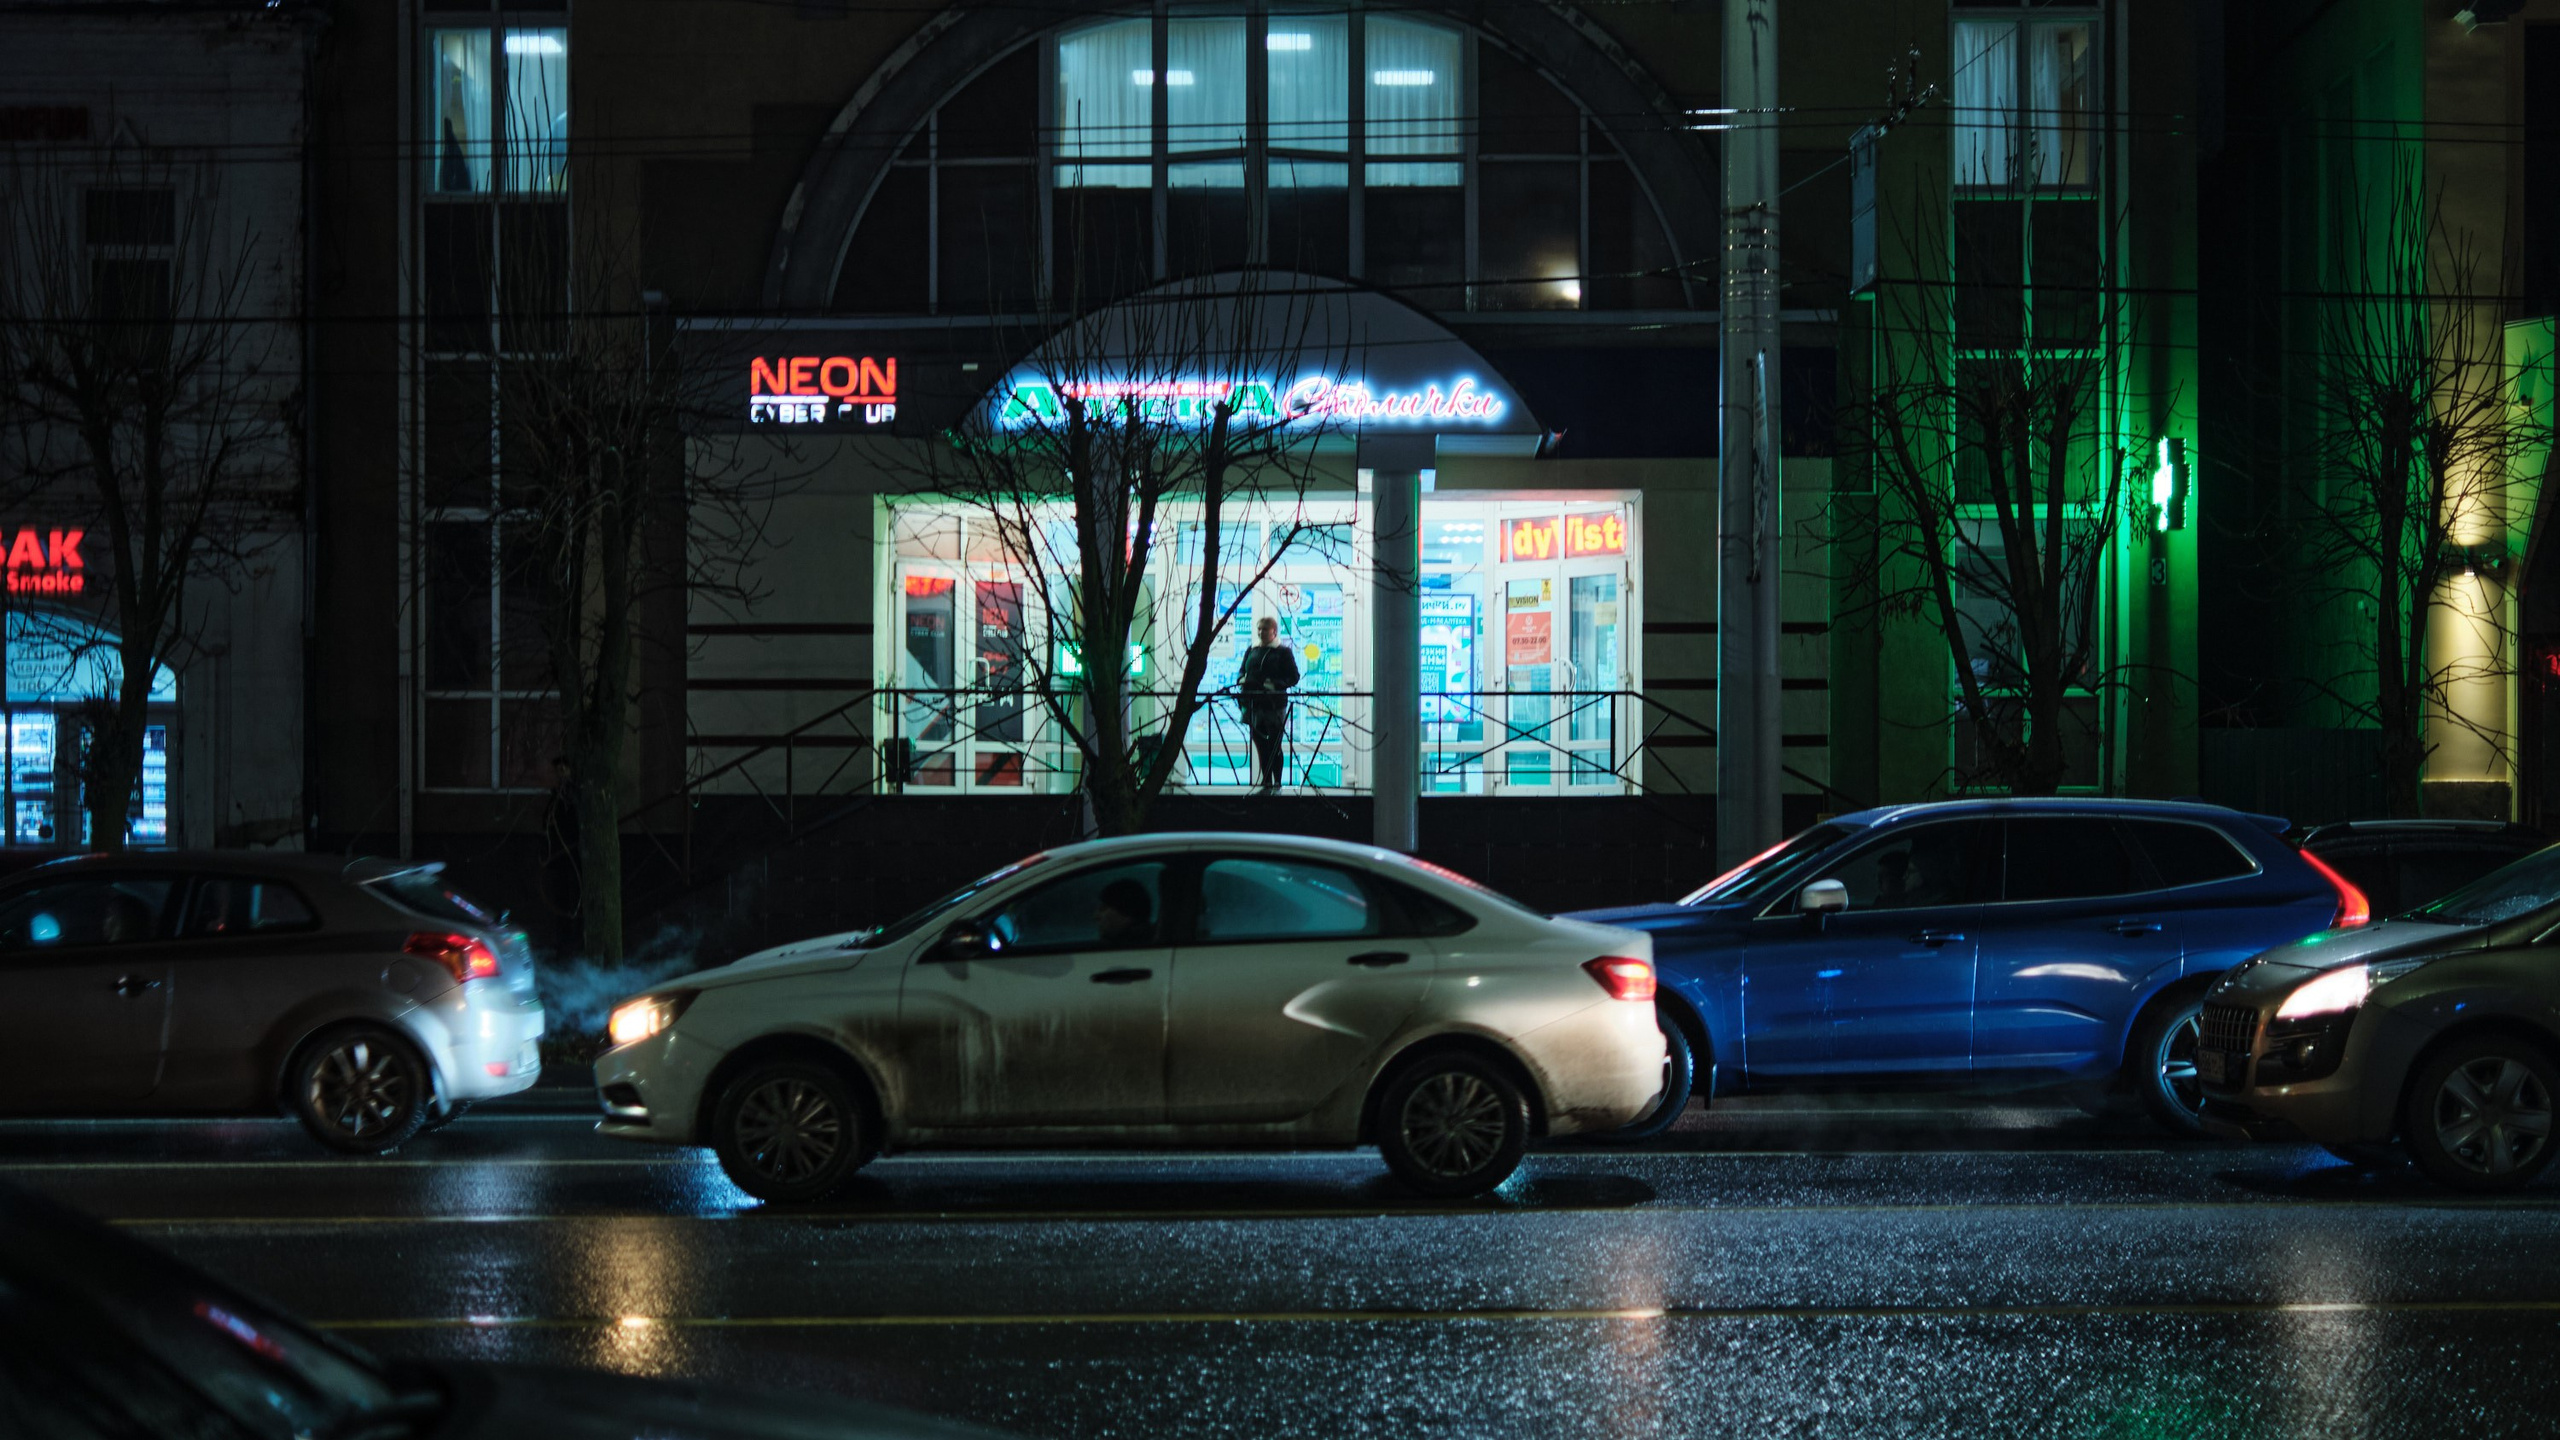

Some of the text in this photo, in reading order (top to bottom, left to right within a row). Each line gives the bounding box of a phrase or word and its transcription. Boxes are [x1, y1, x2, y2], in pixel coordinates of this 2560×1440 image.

[751, 356, 896, 396] NEON
[1283, 376, 1502, 418] Столички
[0, 530, 84, 568] АК
[7, 571, 84, 592] Smoke
[1515, 595, 1539, 605] VISION
